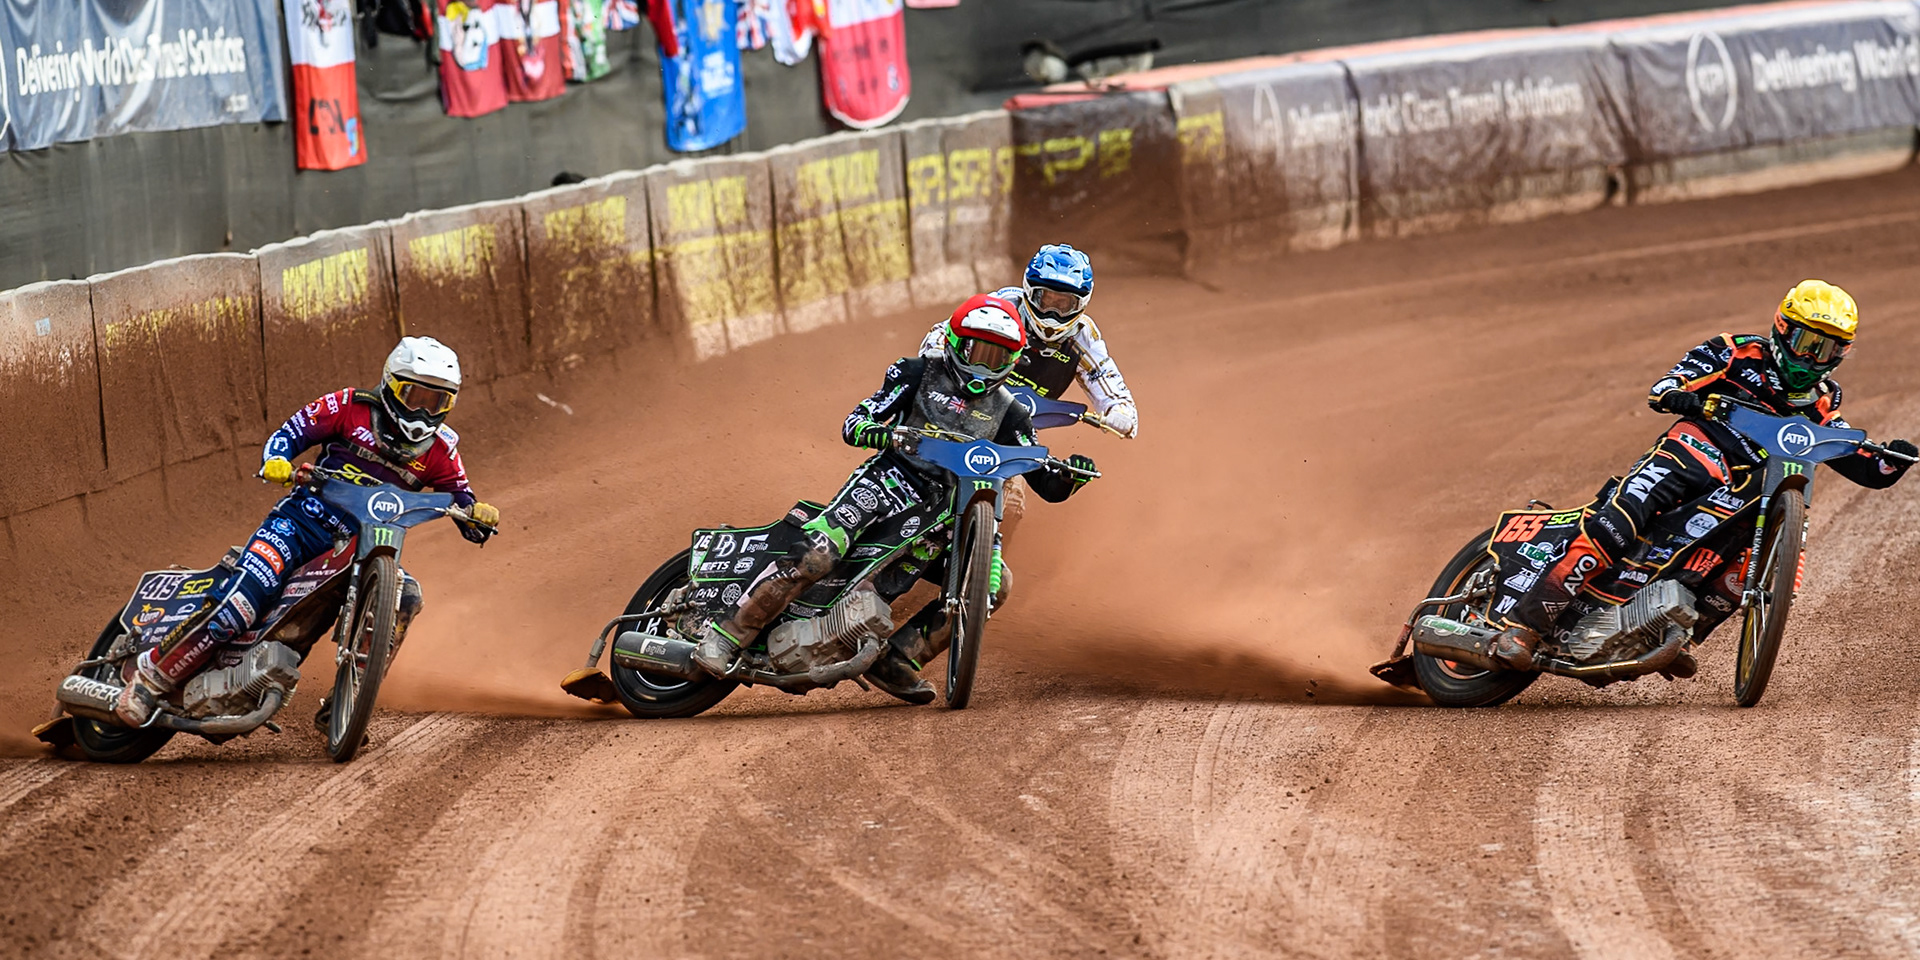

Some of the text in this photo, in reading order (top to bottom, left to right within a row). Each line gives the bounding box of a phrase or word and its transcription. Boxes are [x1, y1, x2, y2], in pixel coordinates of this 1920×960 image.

[16, 40, 81, 102] Delivering
[1750, 44, 1857, 93] Delivering
[1502, 76, 1582, 121] Solutions
[1740, 367, 1763, 387] FIM
[927, 390, 950, 405] FIM
[970, 409, 993, 422] SGP
[351, 425, 377, 446] FIM
[1783, 432, 1809, 447] ATPI
[970, 454, 995, 467] ATPI
[1625, 462, 1673, 503] MK
[373, 500, 398, 514] ATPI
[840, 506, 857, 524] STS
[1547, 511, 1582, 526] SGP
[1493, 514, 1552, 543] 155
[252, 542, 281, 571] KUKA
[256, 528, 292, 562] CARGER
[747, 541, 769, 553] agilia
[1746, 527, 1764, 579] CLEAN WAY
[242, 559, 270, 588] Leszno
[244, 552, 279, 588] Transbud
[305, 568, 337, 577] MAVER
[1562, 554, 1598, 597] AVO
[138, 574, 193, 601] 415
[179, 577, 214, 596] SGP
[645, 641, 667, 656] agilia
[62, 677, 122, 703] CARGER
